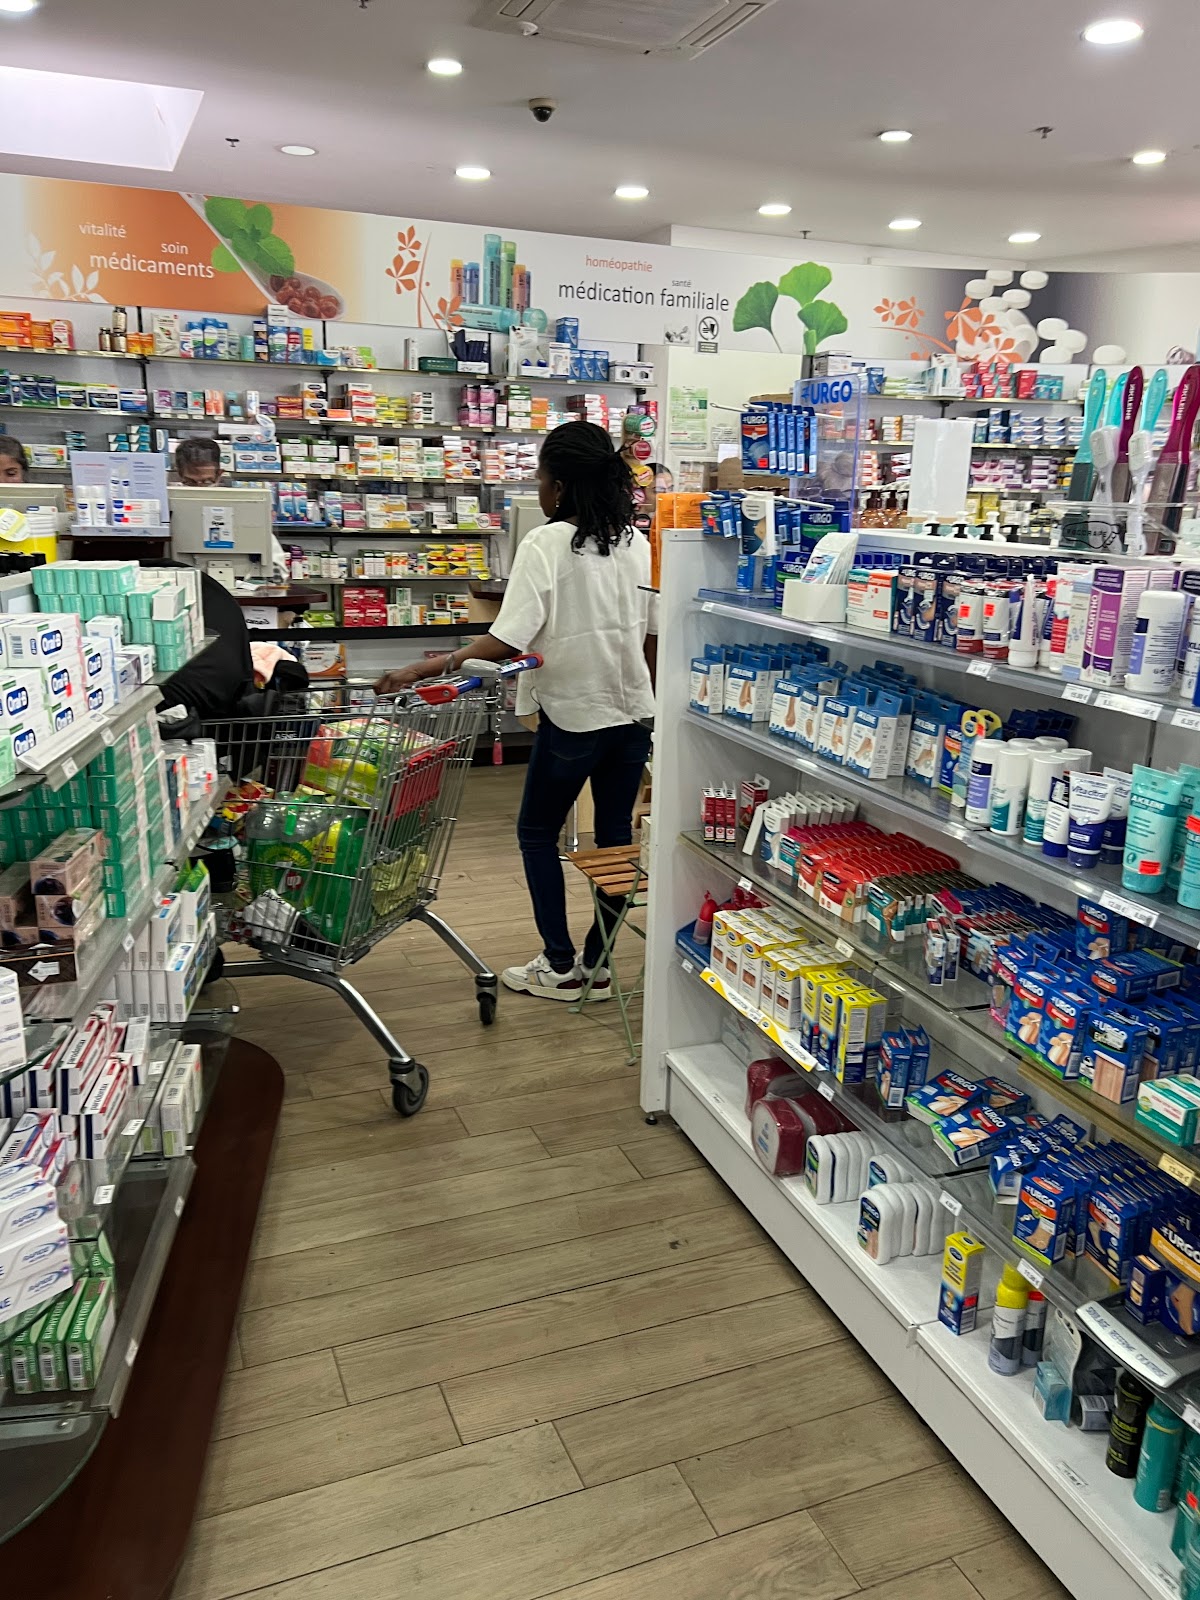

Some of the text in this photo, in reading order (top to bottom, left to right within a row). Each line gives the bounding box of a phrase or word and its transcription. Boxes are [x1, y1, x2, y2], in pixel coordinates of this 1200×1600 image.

[79, 222, 127, 238] vitalité
[161, 242, 189, 255] soin
[89, 252, 215, 279] médicaments
[586, 255, 653, 272] homéopathie
[671, 279, 692, 288] santé
[558, 281, 729, 311] médication familiale
[810, 380, 852, 405] URGO
[746, 415, 768, 425] URGO
[811, 513, 832, 524] URGO
[1085, 593, 1099, 649] AKILORTHO
[1084, 906, 1108, 922] URGO
[1021, 978, 1044, 997] URGO
[1097, 972, 1117, 985] URGO
[1053, 998, 1077, 1017] URGO
[950, 1073, 977, 1092] URGO
[997, 1080, 1024, 1096] URGO
[984, 1108, 1006, 1128] URGO
[1020, 1137, 1040, 1154] URGO
[1028, 1187, 1056, 1208] URGO
[1094, 1198, 1121, 1225] URGO
[1168, 1229, 1200, 1264] URGO
